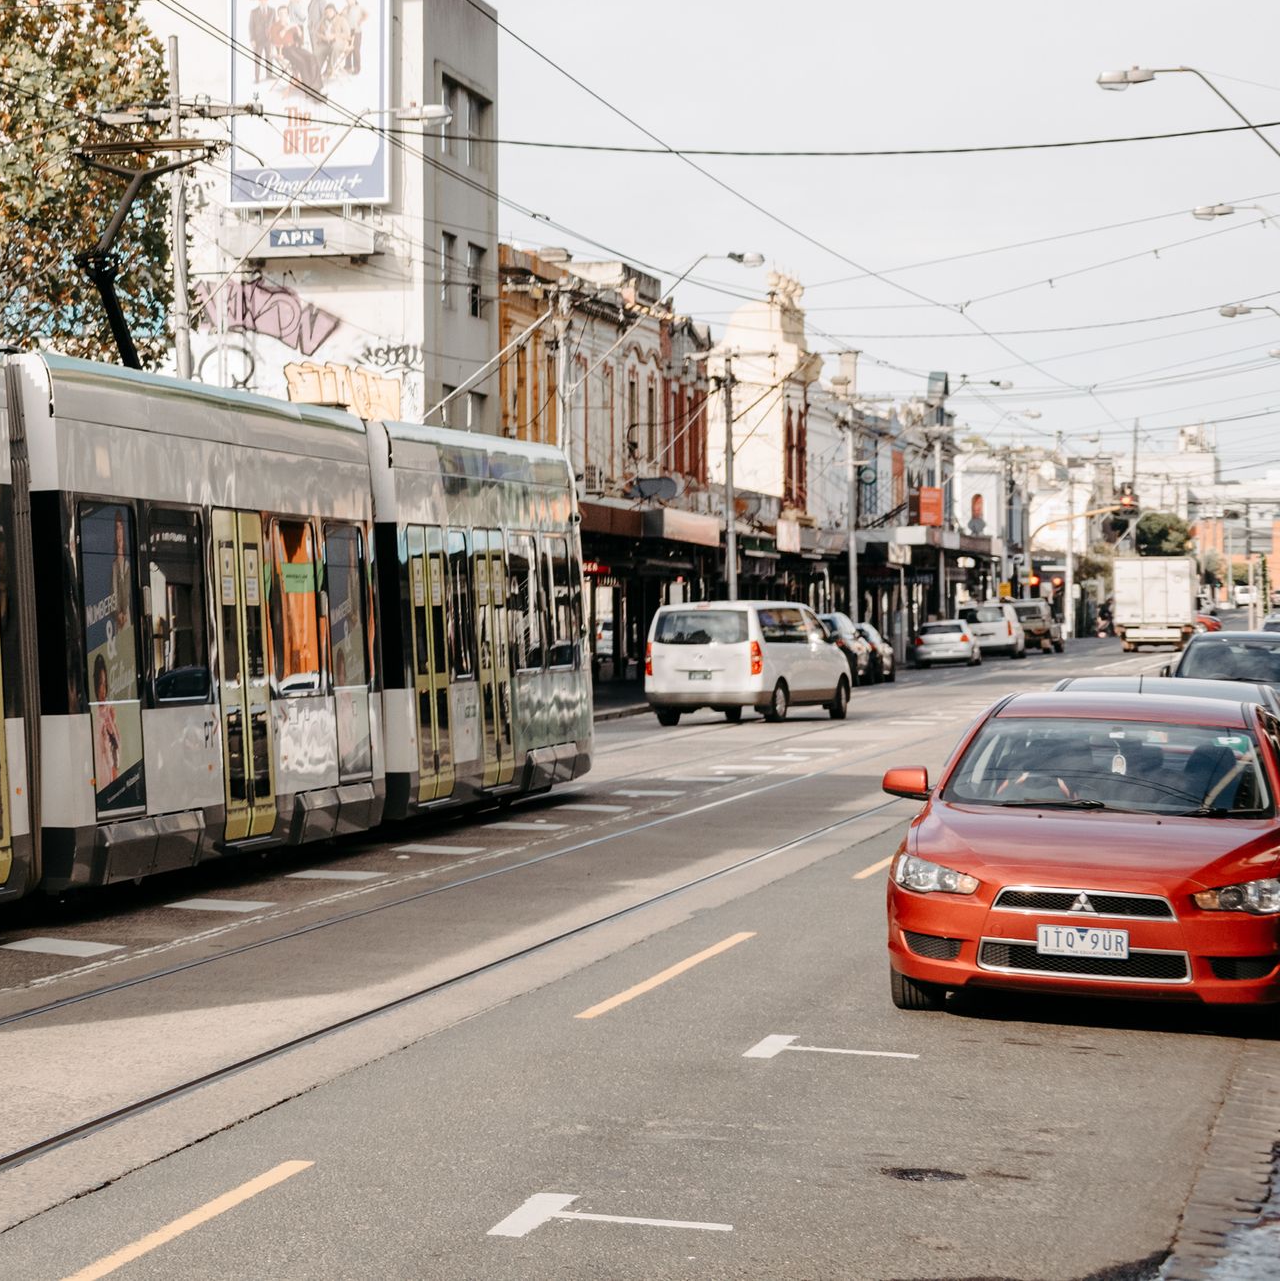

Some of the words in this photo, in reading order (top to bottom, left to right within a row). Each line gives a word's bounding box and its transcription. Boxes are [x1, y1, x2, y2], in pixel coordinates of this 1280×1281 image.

[285, 106, 312, 127] The
[277, 231, 314, 245] APN
[85, 591, 118, 627] NUMBERS
[1044, 930, 1074, 948] 1TQ
[1090, 933, 1124, 952] 9UR
